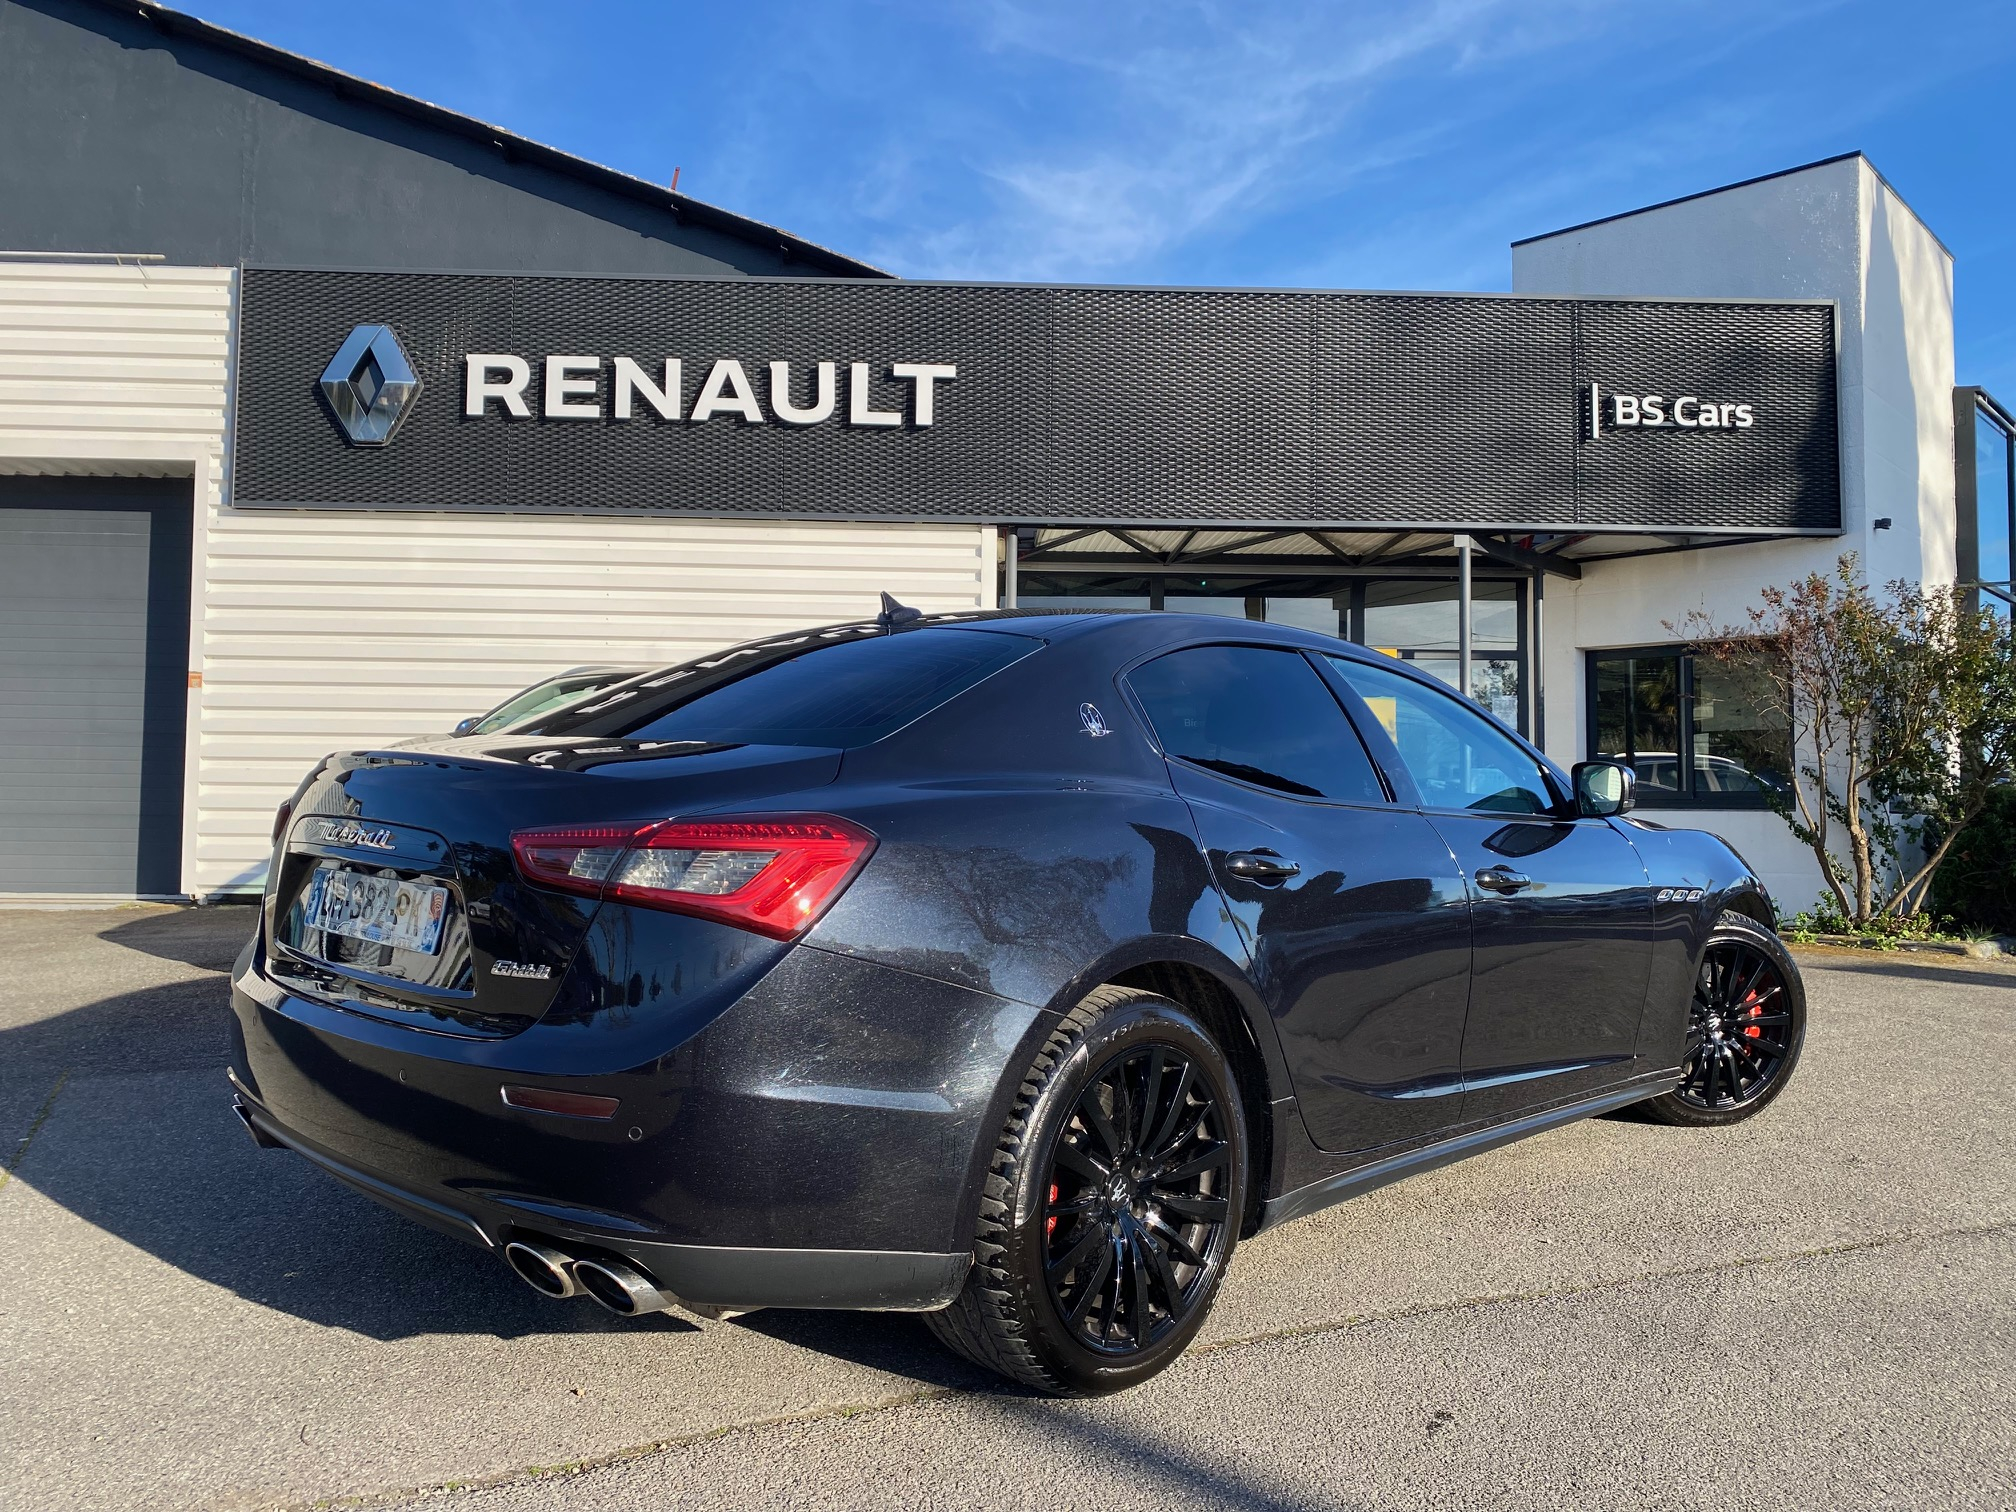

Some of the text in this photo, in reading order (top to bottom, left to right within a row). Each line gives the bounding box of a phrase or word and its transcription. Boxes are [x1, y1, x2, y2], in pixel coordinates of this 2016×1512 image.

[465, 353, 957, 426] RENAULT
[1613, 395, 1754, 427] BS Cars
[490, 960, 551, 980] Ghibli
